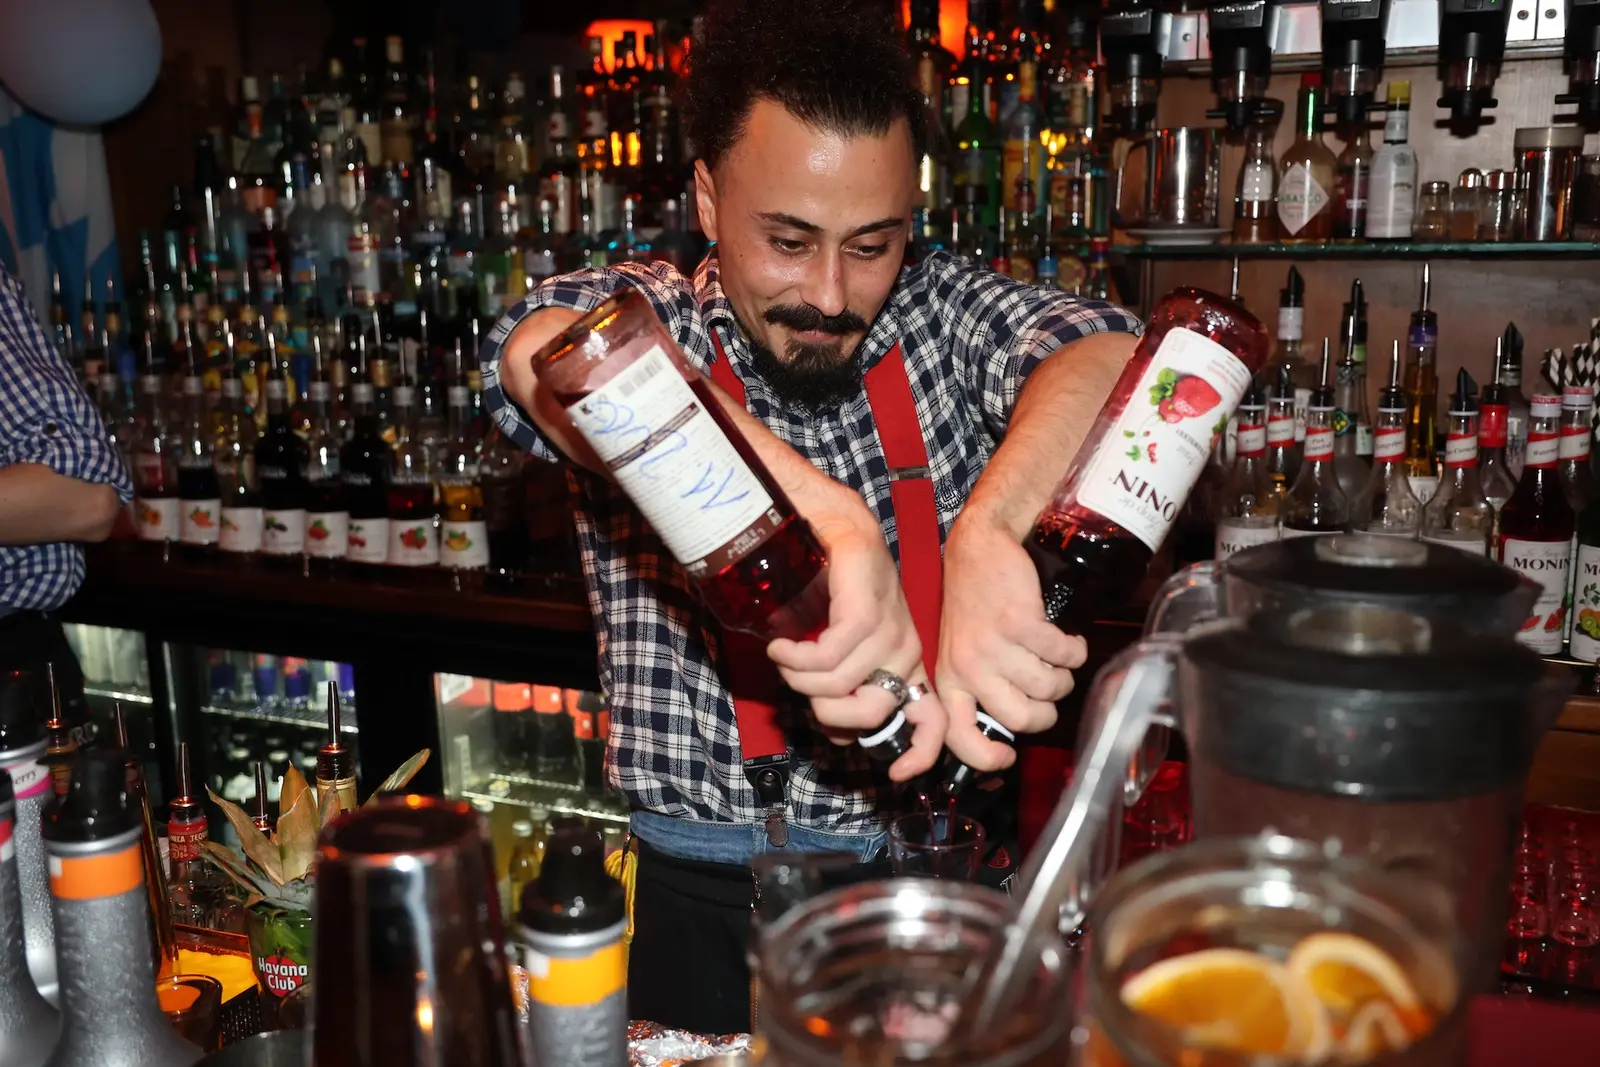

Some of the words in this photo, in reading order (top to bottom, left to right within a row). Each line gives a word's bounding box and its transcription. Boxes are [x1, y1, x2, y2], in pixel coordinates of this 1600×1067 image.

[1279, 193, 1322, 205] ABASCO
[1112, 468, 1177, 522] ONIN
[14, 767, 38, 787] erry
[258, 956, 308, 977] Havana
[267, 974, 297, 991] Club
